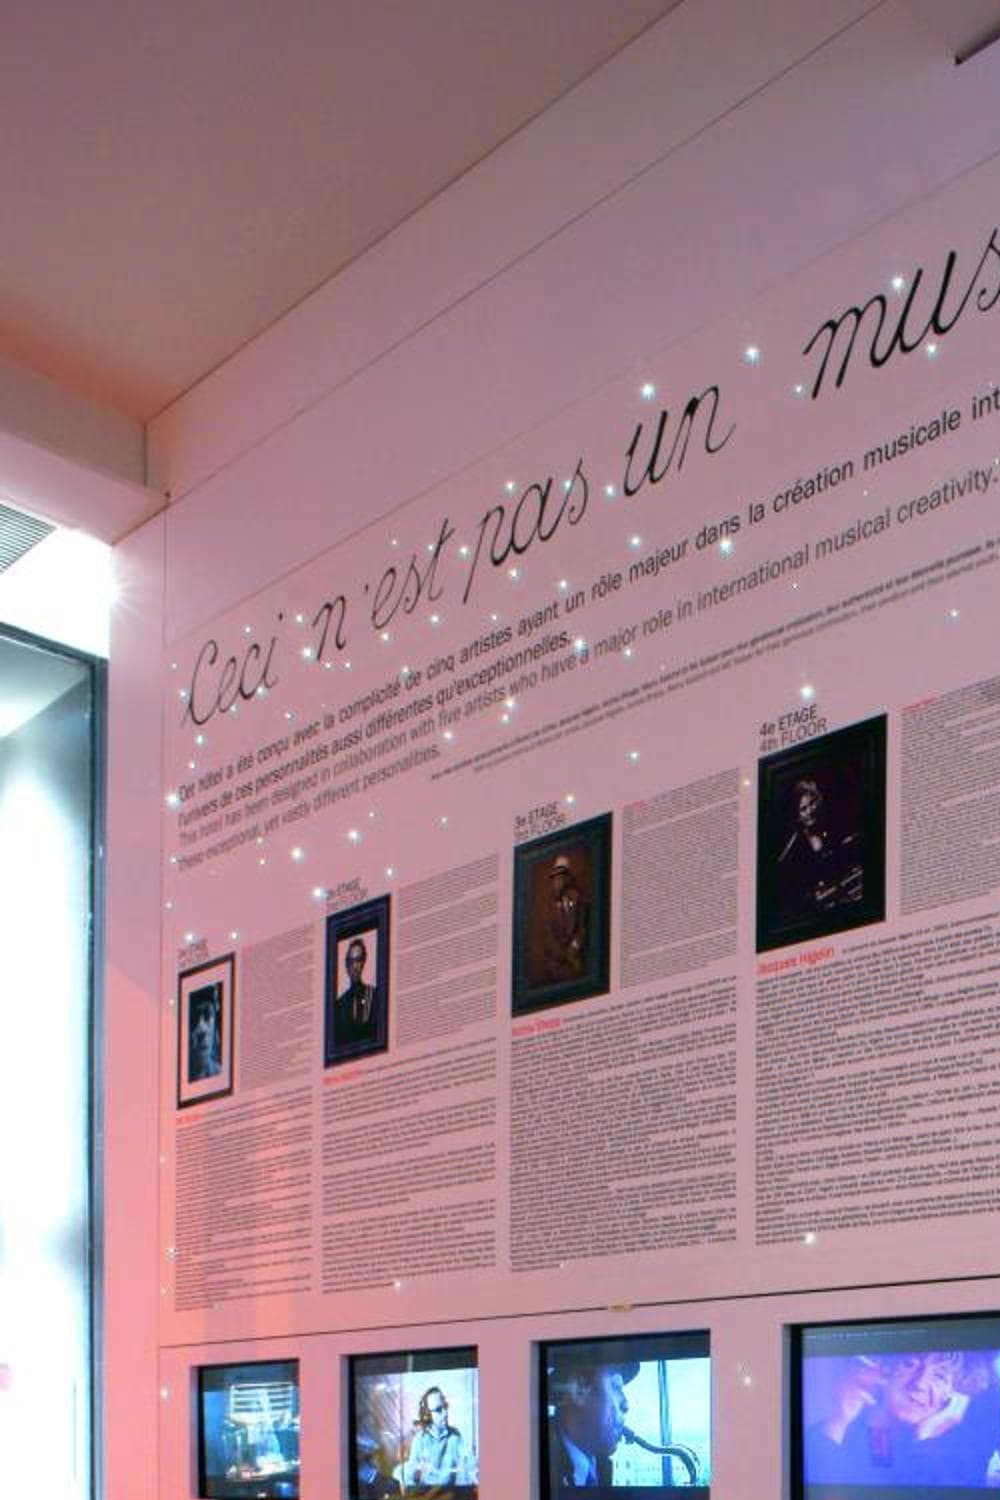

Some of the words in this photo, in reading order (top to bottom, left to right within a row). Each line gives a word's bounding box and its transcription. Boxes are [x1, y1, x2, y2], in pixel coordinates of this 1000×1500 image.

[181, 611, 283, 726] Ceci
[464, 459, 589, 604] pas
[623, 385, 737, 497] un
[334, 732, 406, 776] collaboration
[410, 717, 435, 740] with
[438, 707, 461, 727] five
[464, 686, 505, 717] artists
[510, 672, 537, 696] who
[541, 654, 577, 682] have
[594, 625, 638, 657] major
[642, 609, 672, 636] role
[677, 600, 692, 621] in
[698, 544, 809, 612] international
[816, 507, 891, 560] musical
[897, 463, 998, 524] creativity.
[427, 655, 455, 680] cinq
[459, 626, 512, 664] artistes
[518, 601, 558, 637] ayant
[565, 591, 585, 613] un
[592, 573, 622, 600] rôle
[629, 539, 688, 583] majeur
[695, 515, 741, 550] dans
[749, 503, 765, 525] la
[773, 461, 853, 513] création
[864, 410, 961, 471] musicale
[331, 730, 362, 755] aussi
[366, 695, 433, 738] différentes
[436, 631, 571, 707] qu'exceptionnelles.
[779, 703, 818, 731] ETAGE
[781, 717, 828, 747] FLOOR
